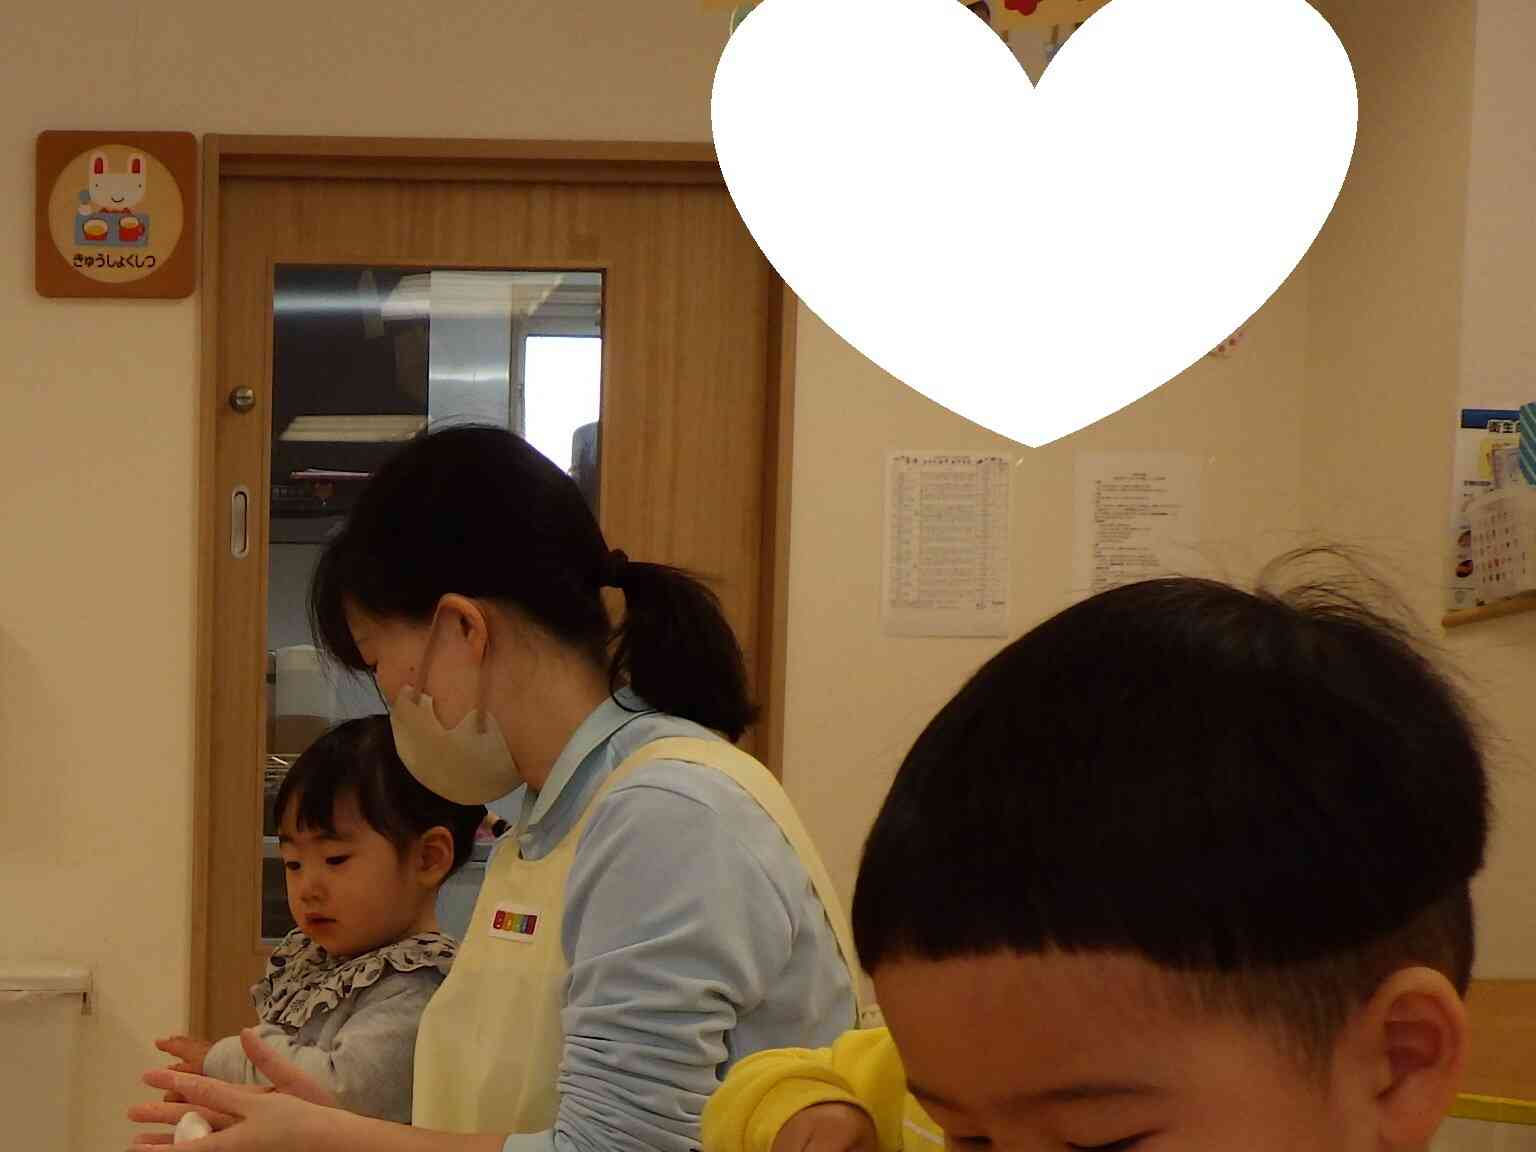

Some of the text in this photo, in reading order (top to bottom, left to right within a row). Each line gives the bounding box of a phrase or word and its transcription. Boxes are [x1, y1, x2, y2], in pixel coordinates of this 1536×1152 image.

[73, 253, 156, 268] きゅうしょくしつ
